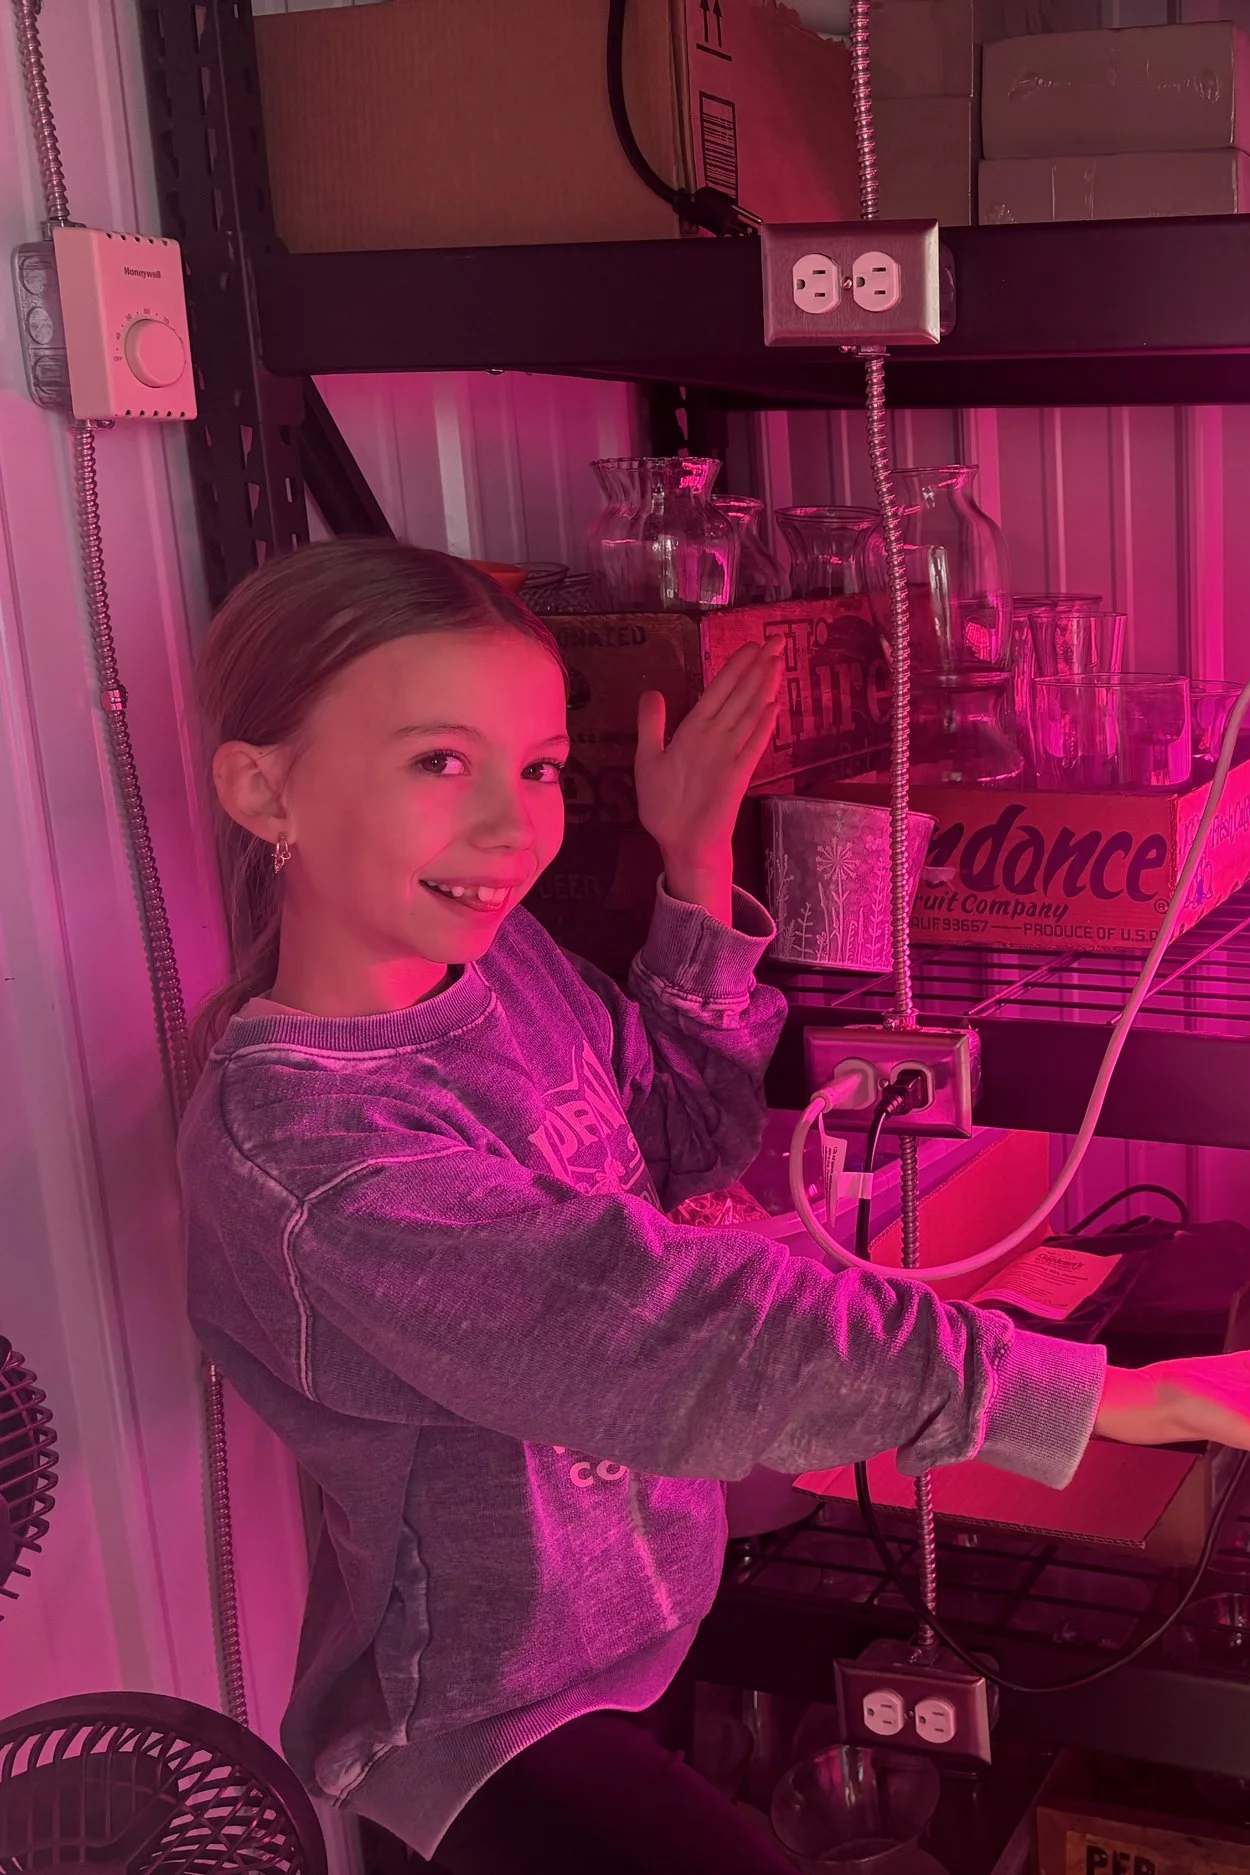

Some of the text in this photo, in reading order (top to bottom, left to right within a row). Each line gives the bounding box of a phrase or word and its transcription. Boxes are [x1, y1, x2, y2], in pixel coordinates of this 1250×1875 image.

[124, 266, 161, 279] Honeywell
[914, 890, 1070, 922] ruit Company
[911, 916, 940, 931] ALIF
[942, 919, 989, 933] 93657
[1023, 922, 1093, 940] PRODUCE
[1096, 926, 1117, 941] OF
